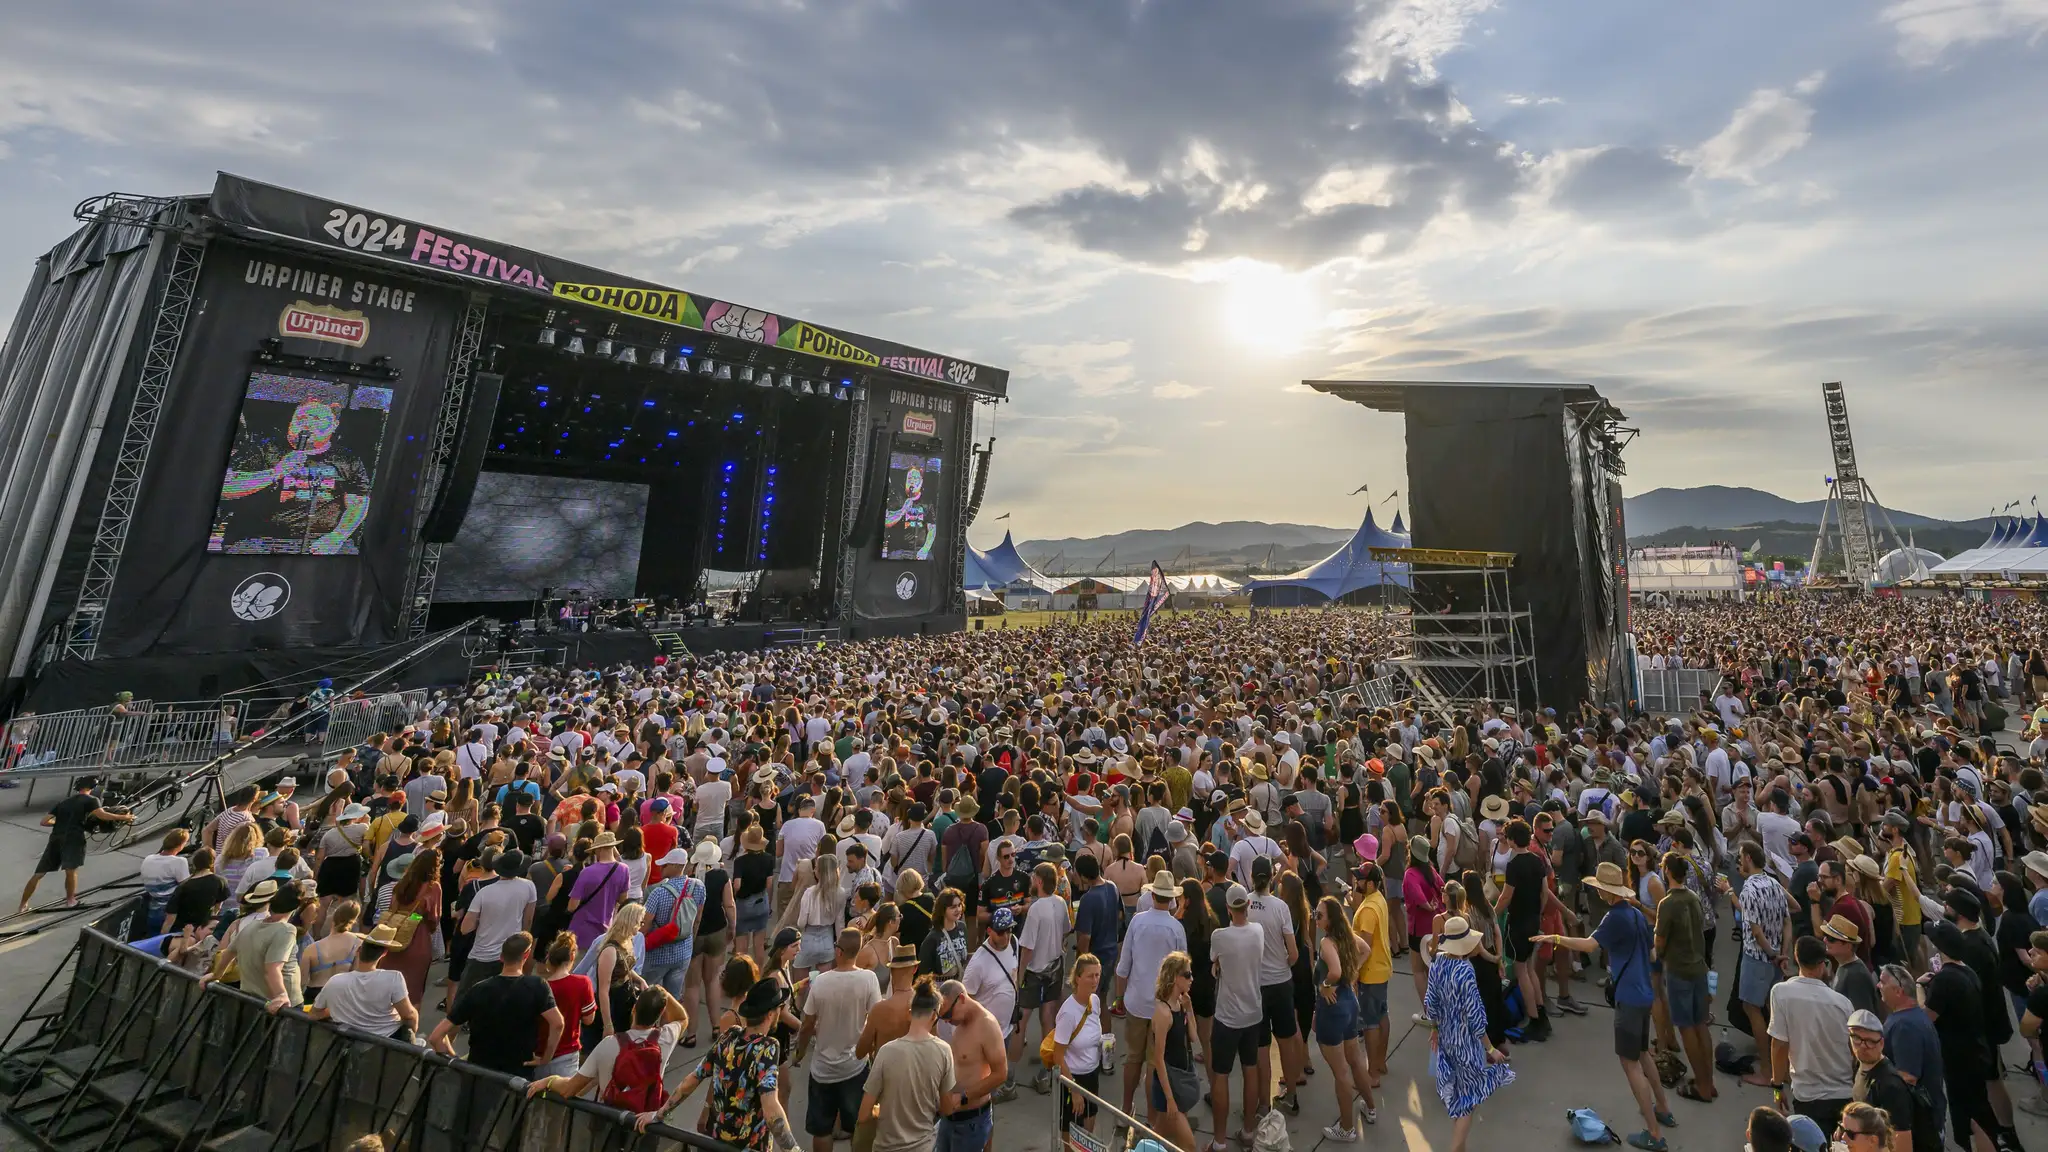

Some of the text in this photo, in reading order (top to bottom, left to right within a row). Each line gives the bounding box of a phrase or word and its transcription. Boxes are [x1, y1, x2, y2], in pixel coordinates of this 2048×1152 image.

[323, 208, 679, 321] 2024 FESTIVAL POHODA
[244, 260, 416, 313] URPINER STAGE
[290, 312, 362, 337] Urpiner
[798, 325, 977, 385] POHODA FESTIVAL 2024
[889, 389, 952, 413] URPINER STAGE
[906, 418, 933, 431] Urpiner
